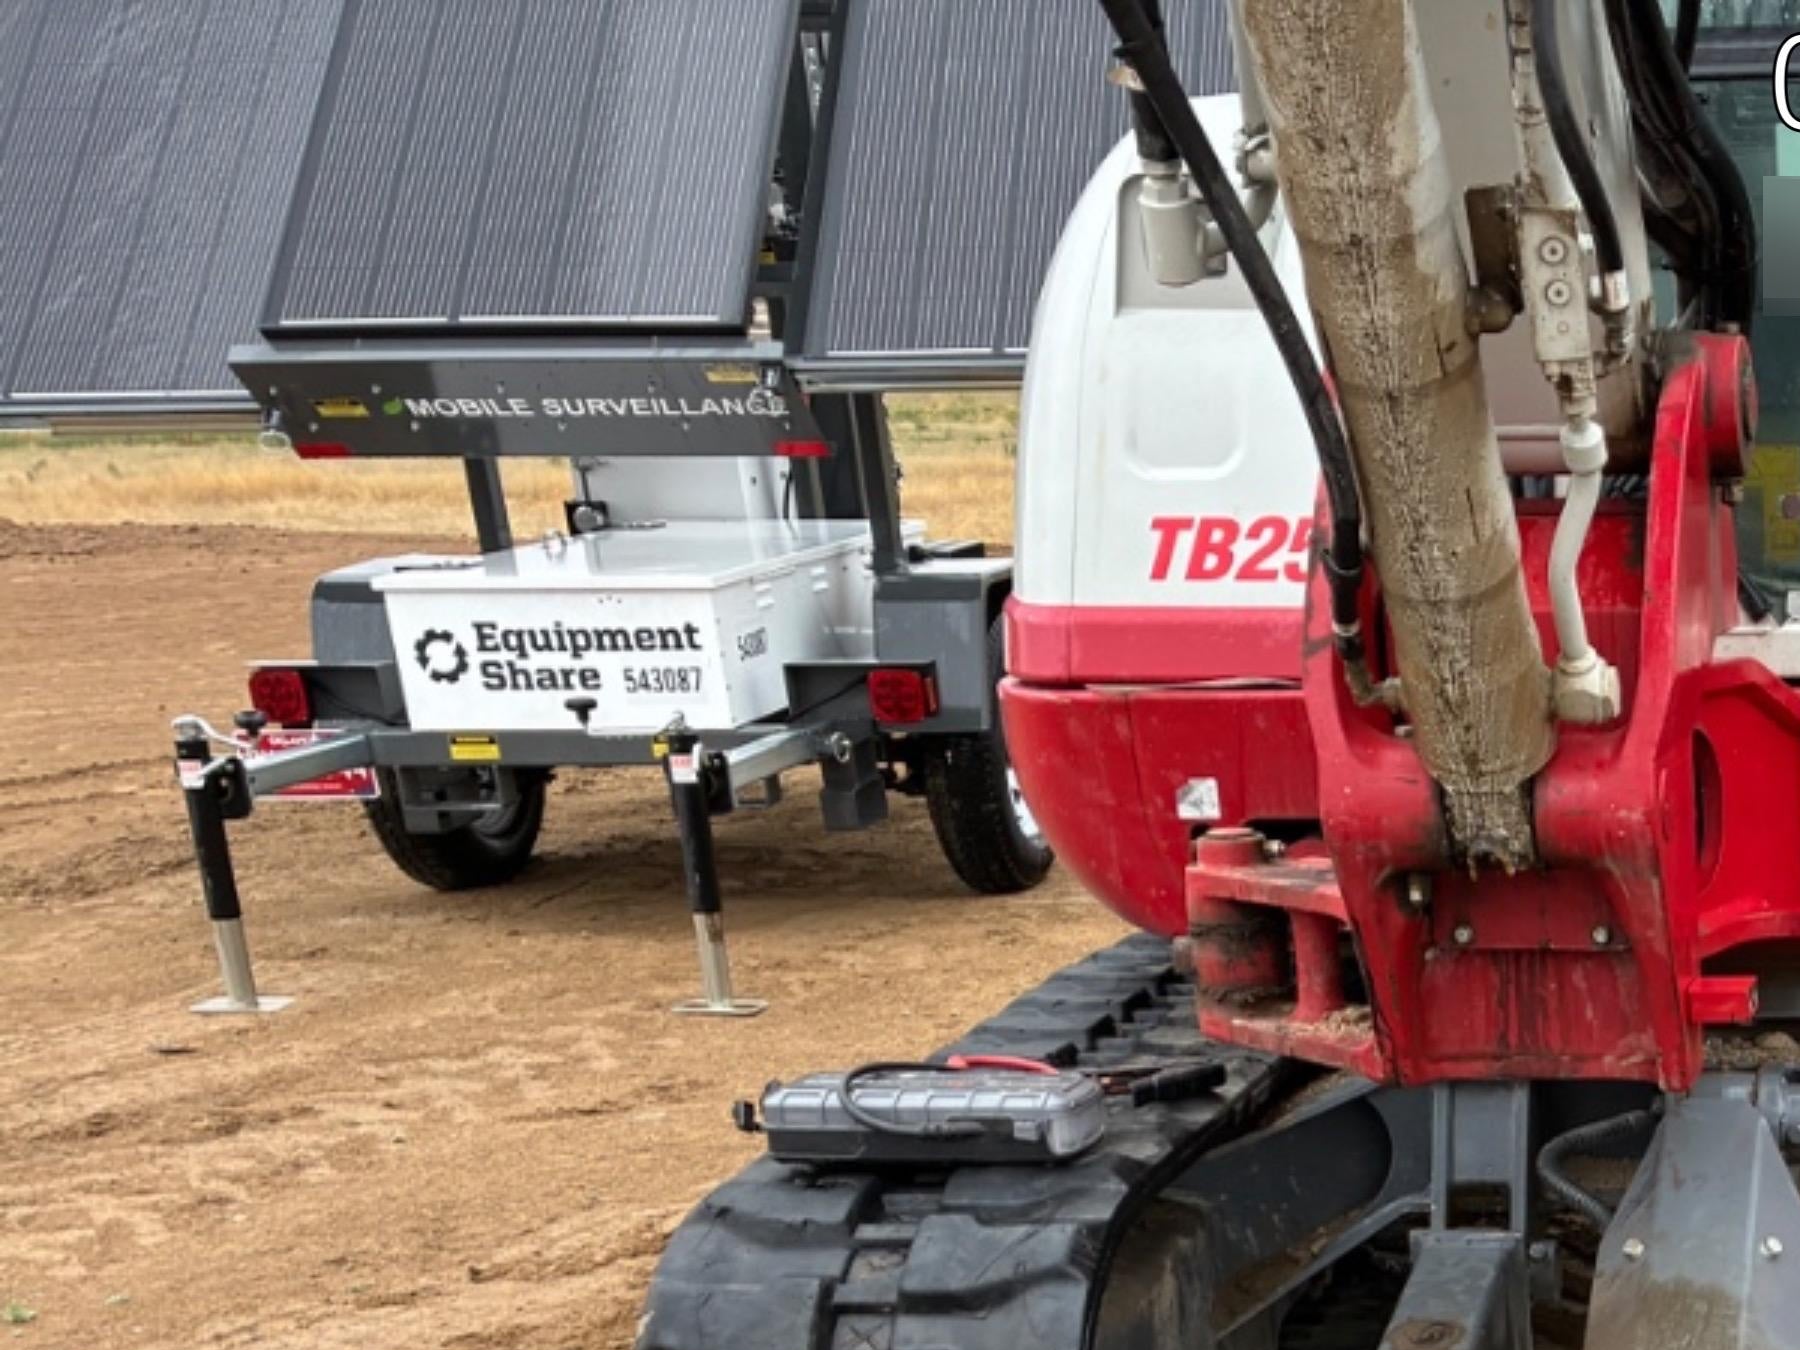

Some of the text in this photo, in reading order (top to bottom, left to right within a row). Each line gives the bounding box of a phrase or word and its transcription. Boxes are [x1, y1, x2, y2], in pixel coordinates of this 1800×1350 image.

[404, 397, 535, 416] MOBILE
[471, 621, 703, 659] Equipment
[479, 659, 602, 690] Share
[623, 666, 702, 693] 543087
